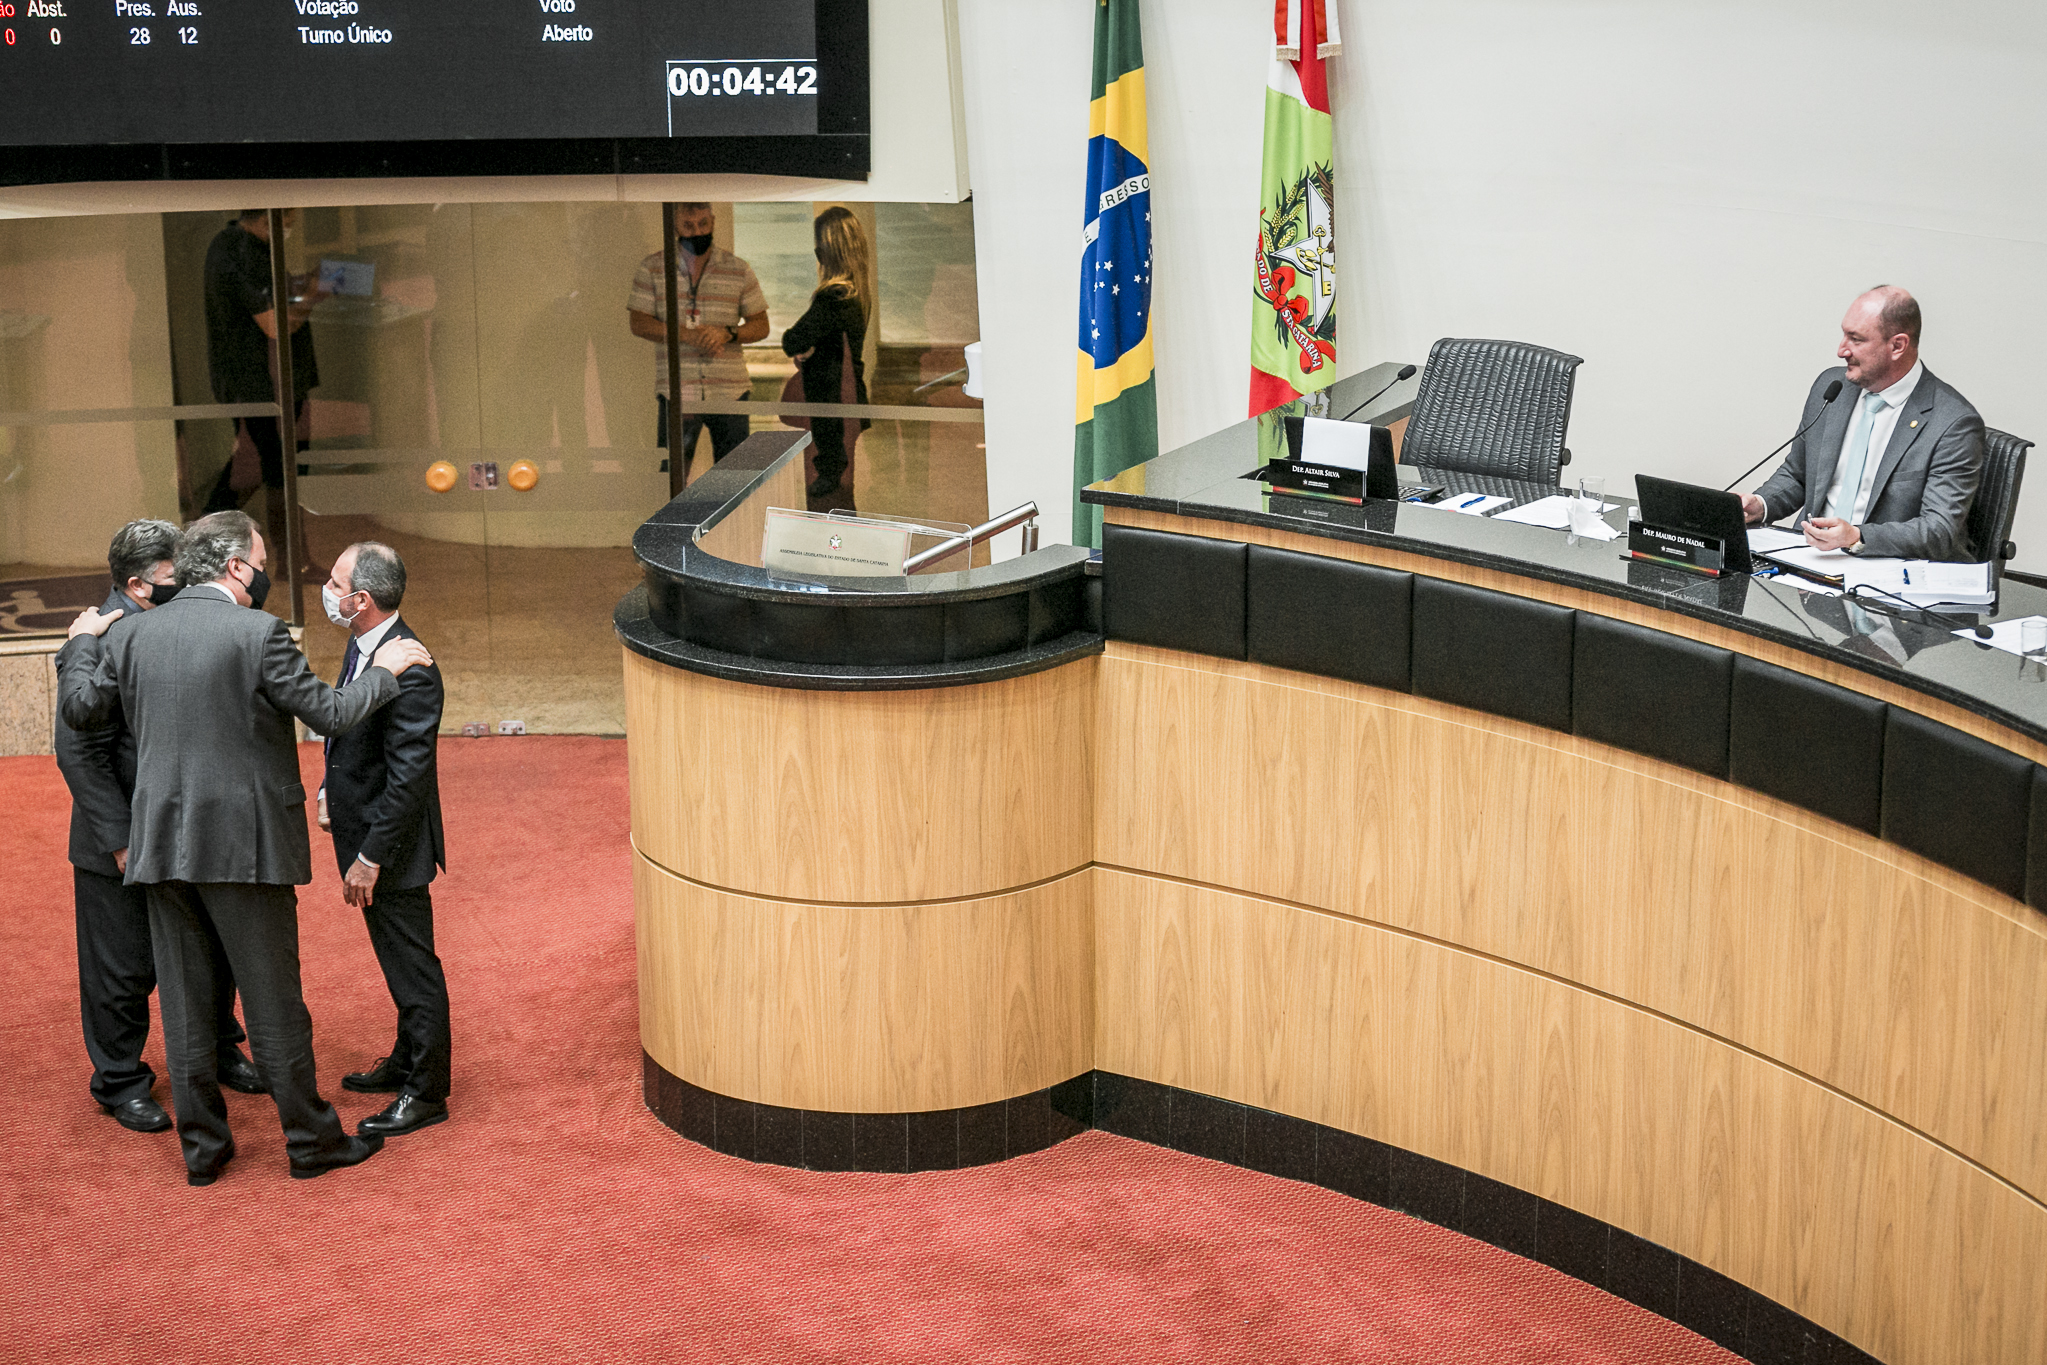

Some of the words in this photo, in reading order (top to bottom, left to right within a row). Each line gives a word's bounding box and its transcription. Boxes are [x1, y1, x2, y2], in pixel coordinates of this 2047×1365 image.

[27, 0, 67, 17] Abst.
[116, 0, 155, 17] Pres.
[167, 0, 202, 16] Aus.
[294, 0, 359, 19] Votação
[539, 0, 576, 13] Voto
[4, 28, 16, 46] 0
[50, 28, 61, 45] 0
[130, 28, 151, 45] 28
[178, 27, 199, 44] 12
[298, 26, 345, 44] Turno
[347, 22, 392, 43] Único
[541, 24, 594, 41] Aberto
[668, 66, 818, 96] 00:04:42
[1292, 327, 1322, 368] CATARINA
